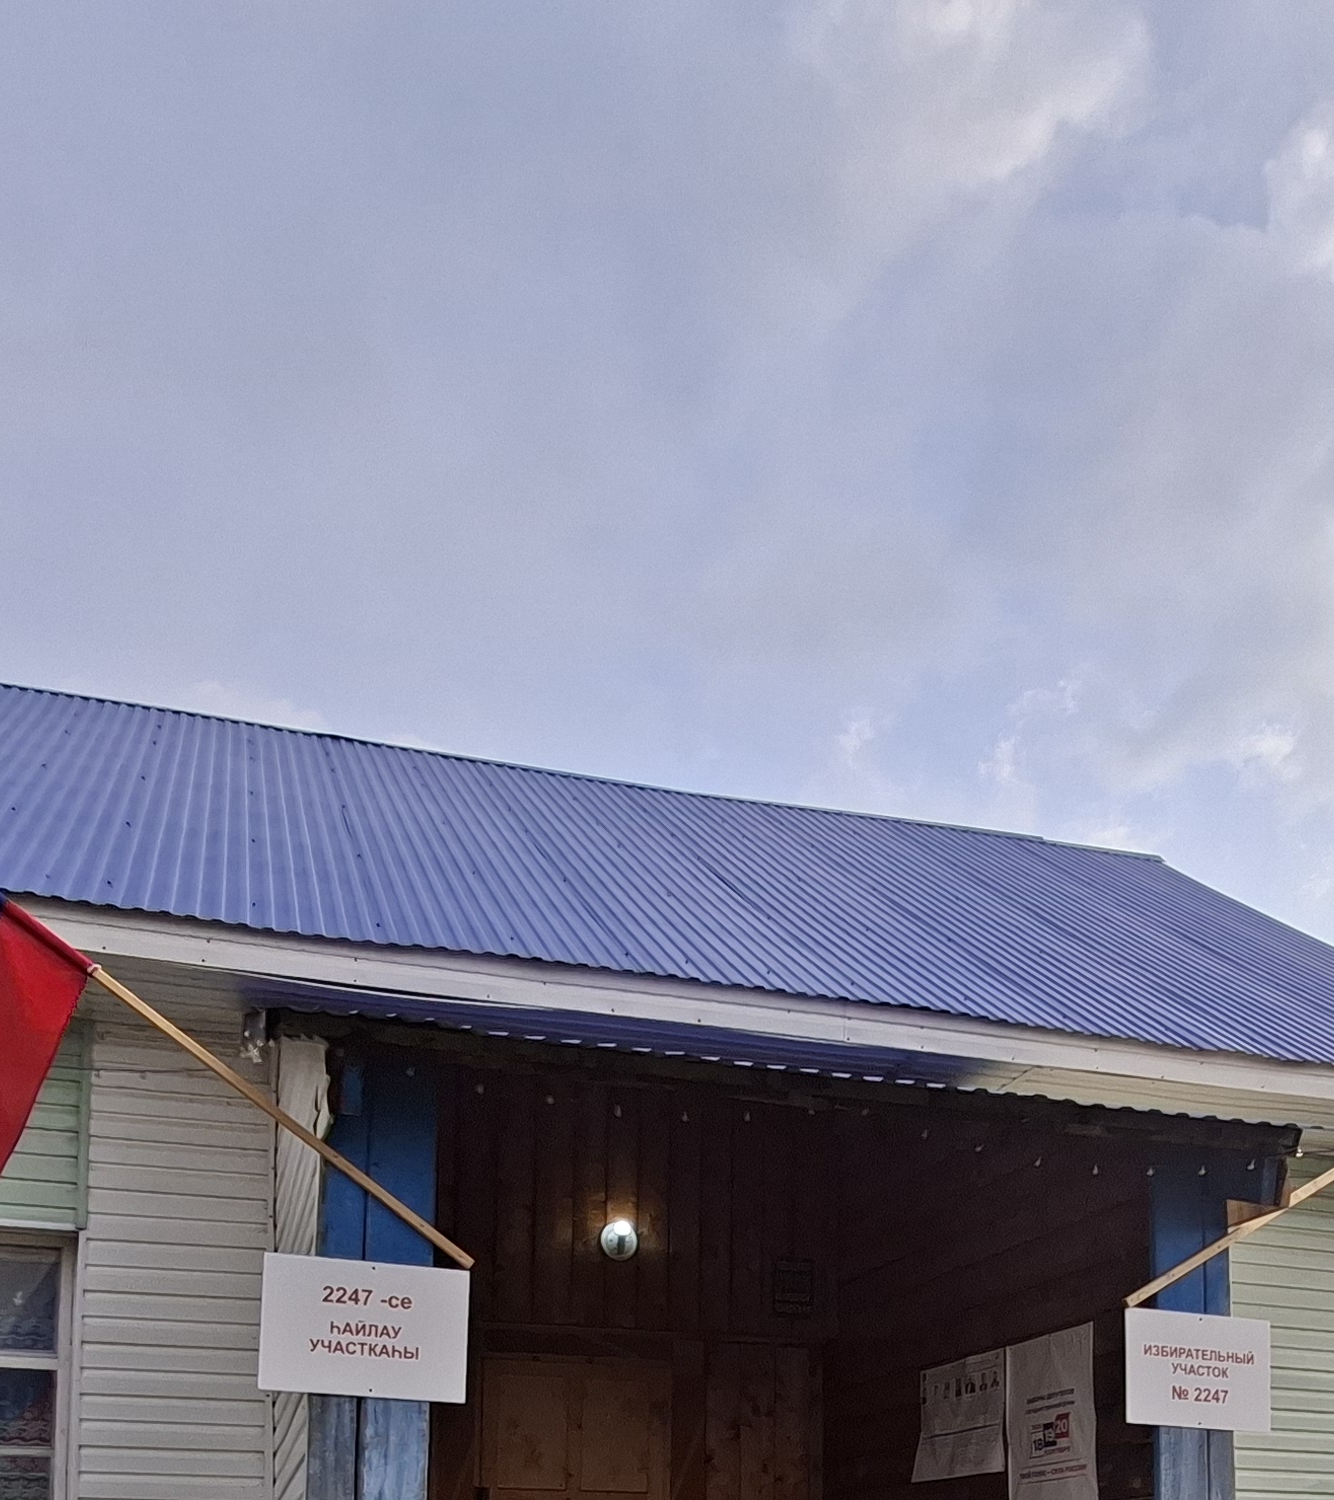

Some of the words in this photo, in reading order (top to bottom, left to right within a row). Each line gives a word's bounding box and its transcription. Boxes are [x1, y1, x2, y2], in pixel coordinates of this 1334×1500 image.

[322, 1286, 373, 1306] 2247
[1143, 1343, 1255, 1365] ИЗБИРАТЕЛЬНЫЙ
[1171, 1362, 1229, 1379] УЧАСТОК
[1171, 1385, 1189, 1400] №
[1193, 1387, 1229, 1404] 2247
[1055, 1419, 1068, 1433] 20
